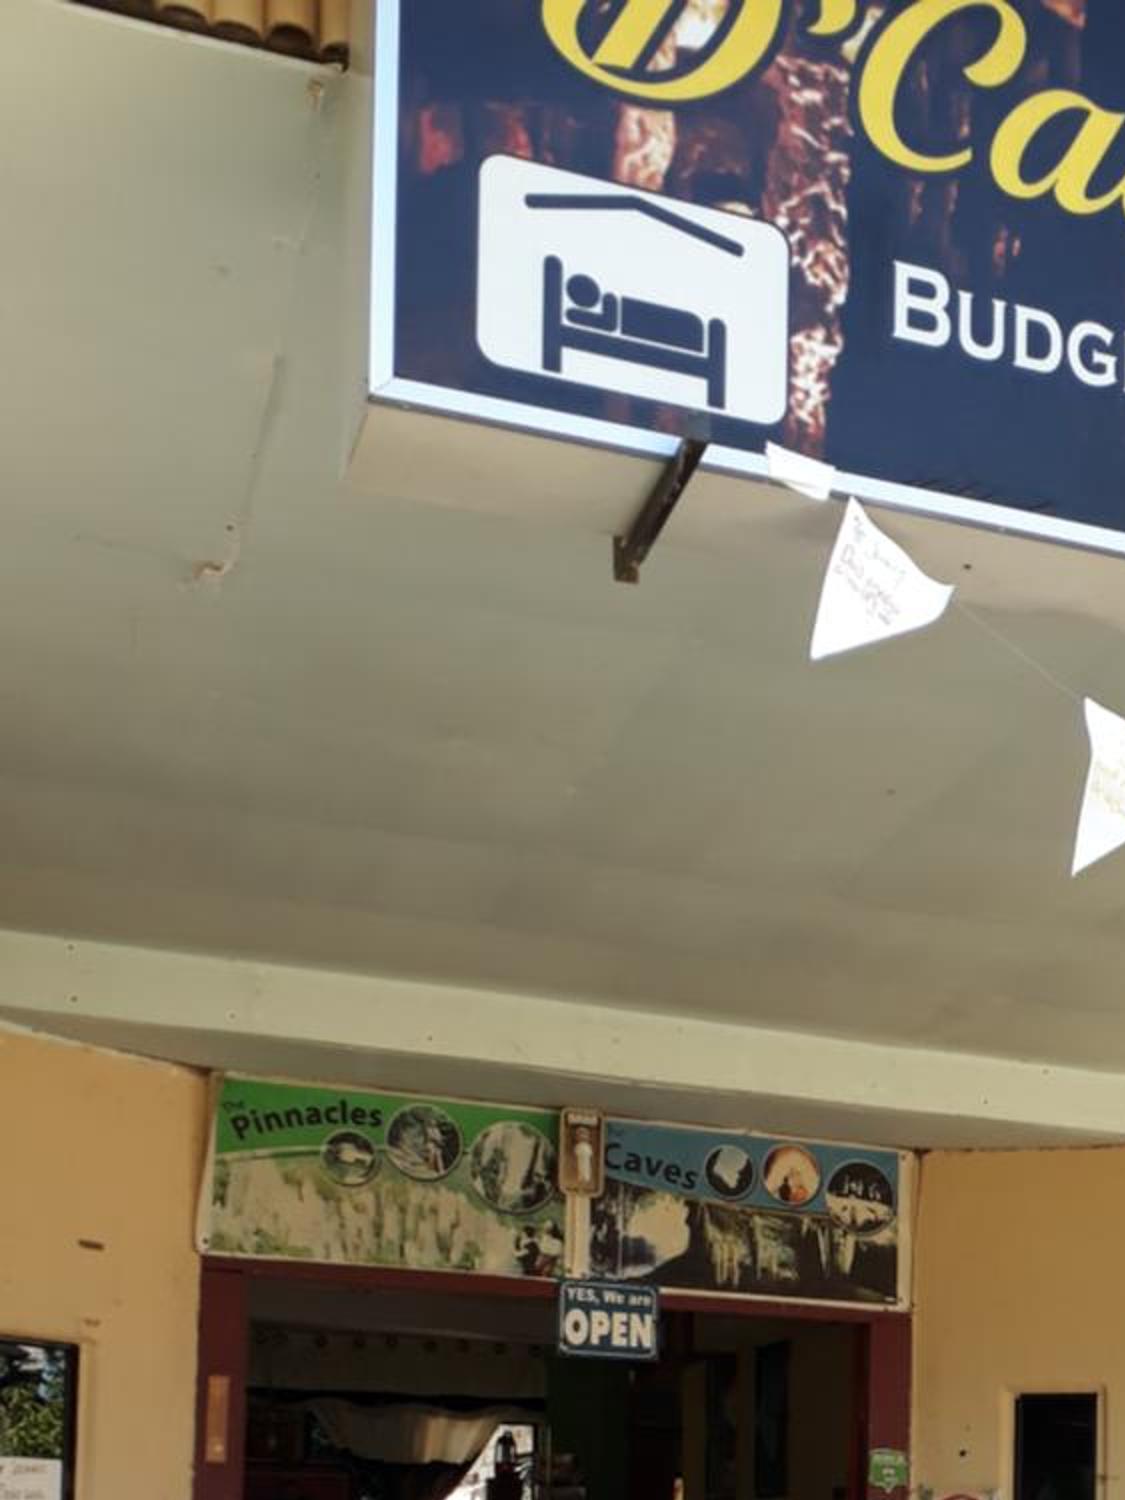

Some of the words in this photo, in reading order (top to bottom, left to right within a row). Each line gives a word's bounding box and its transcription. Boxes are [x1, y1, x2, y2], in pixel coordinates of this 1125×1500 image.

[230, 1099, 384, 1140] Pinnacles
[605, 1142, 699, 1191] Caves
[567, 1287, 601, 1306] YES,
[565, 1309, 653, 1347] OPEN
